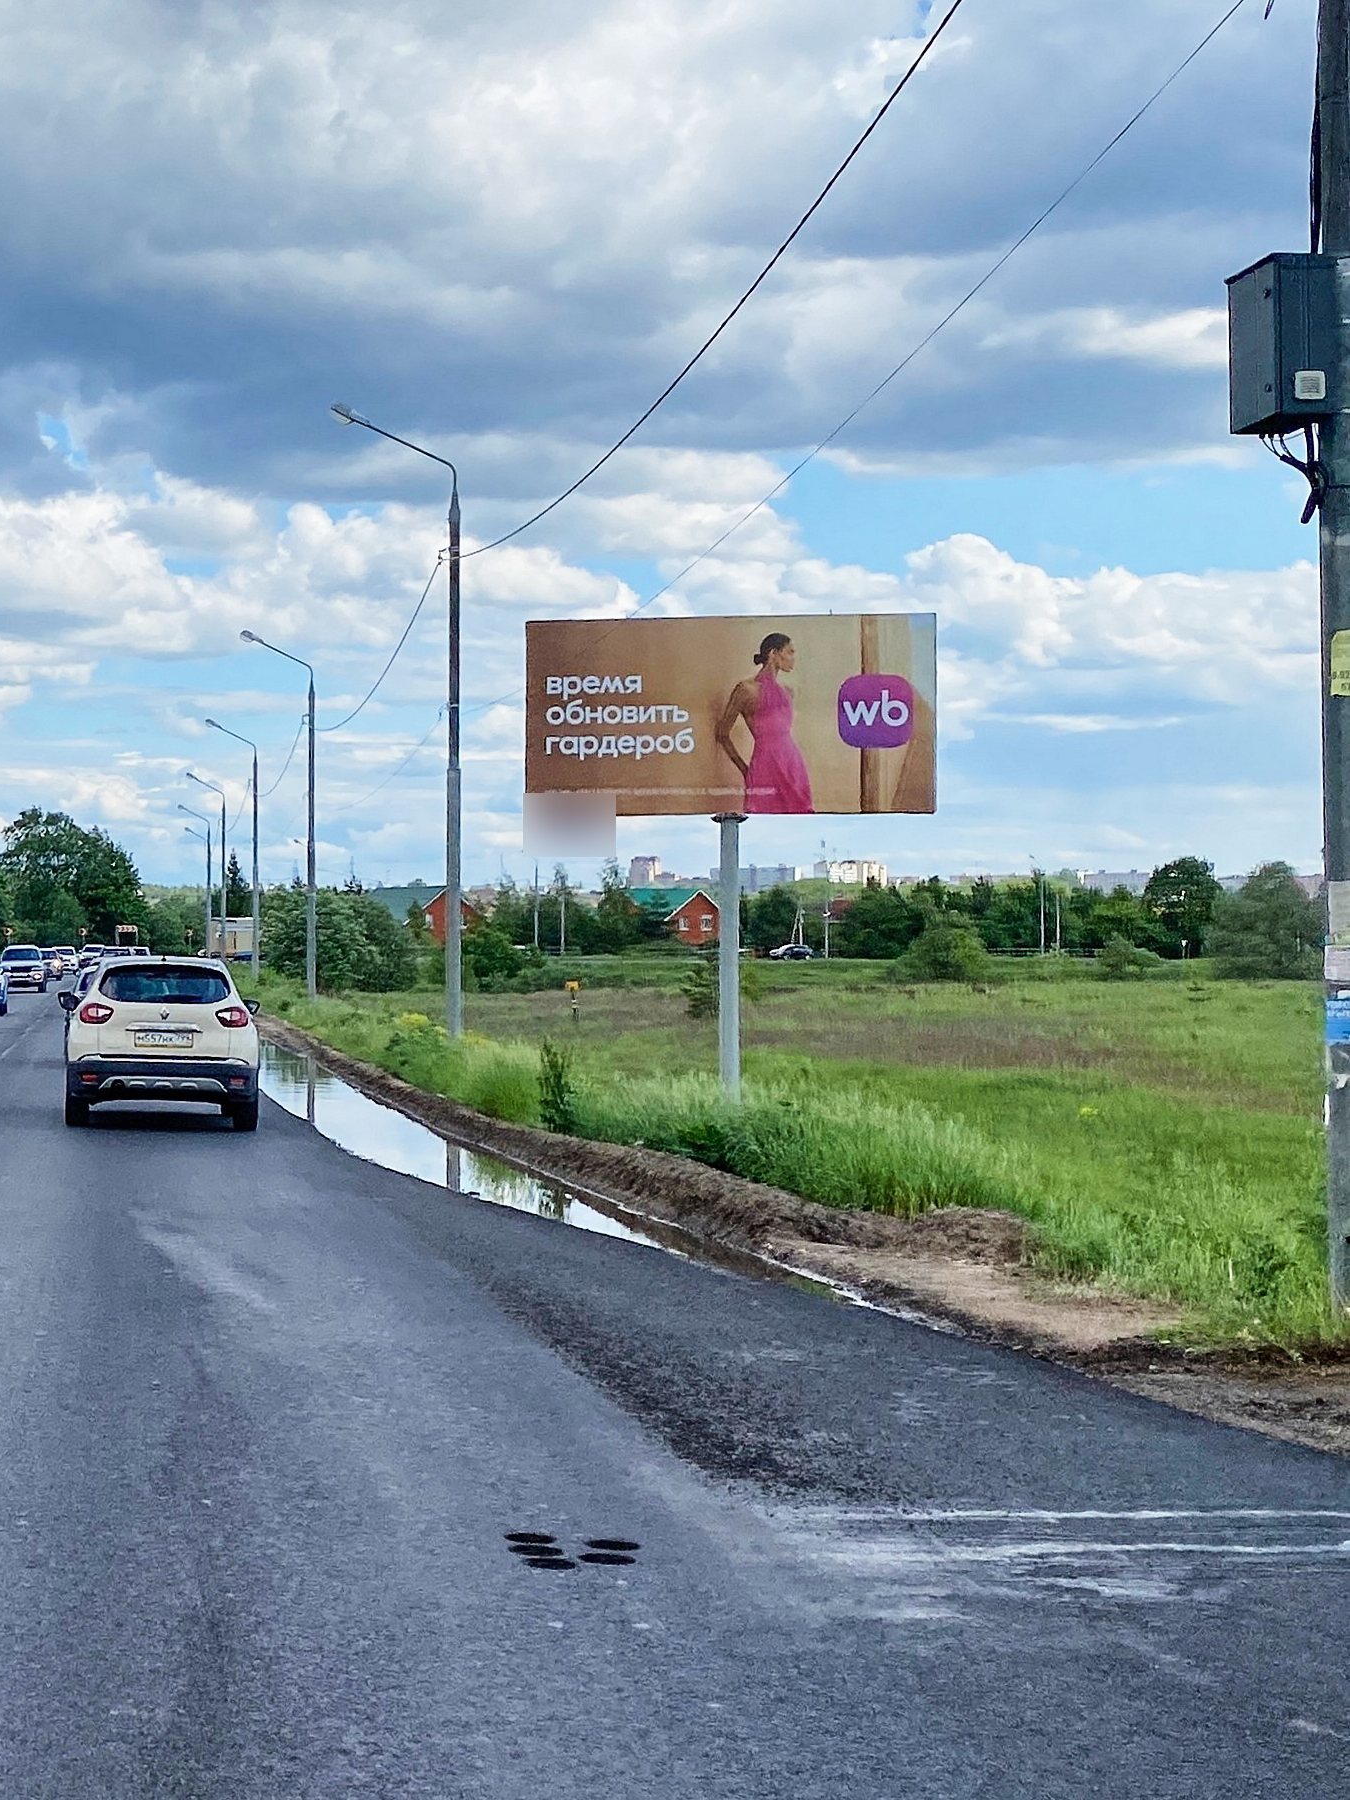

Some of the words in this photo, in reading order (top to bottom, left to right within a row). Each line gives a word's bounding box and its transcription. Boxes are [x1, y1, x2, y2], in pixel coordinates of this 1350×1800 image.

[546, 675, 643, 700] время
[546, 699, 690, 725] обновить
[843, 690, 909, 727] wb
[546, 728, 695, 760] гардероб
